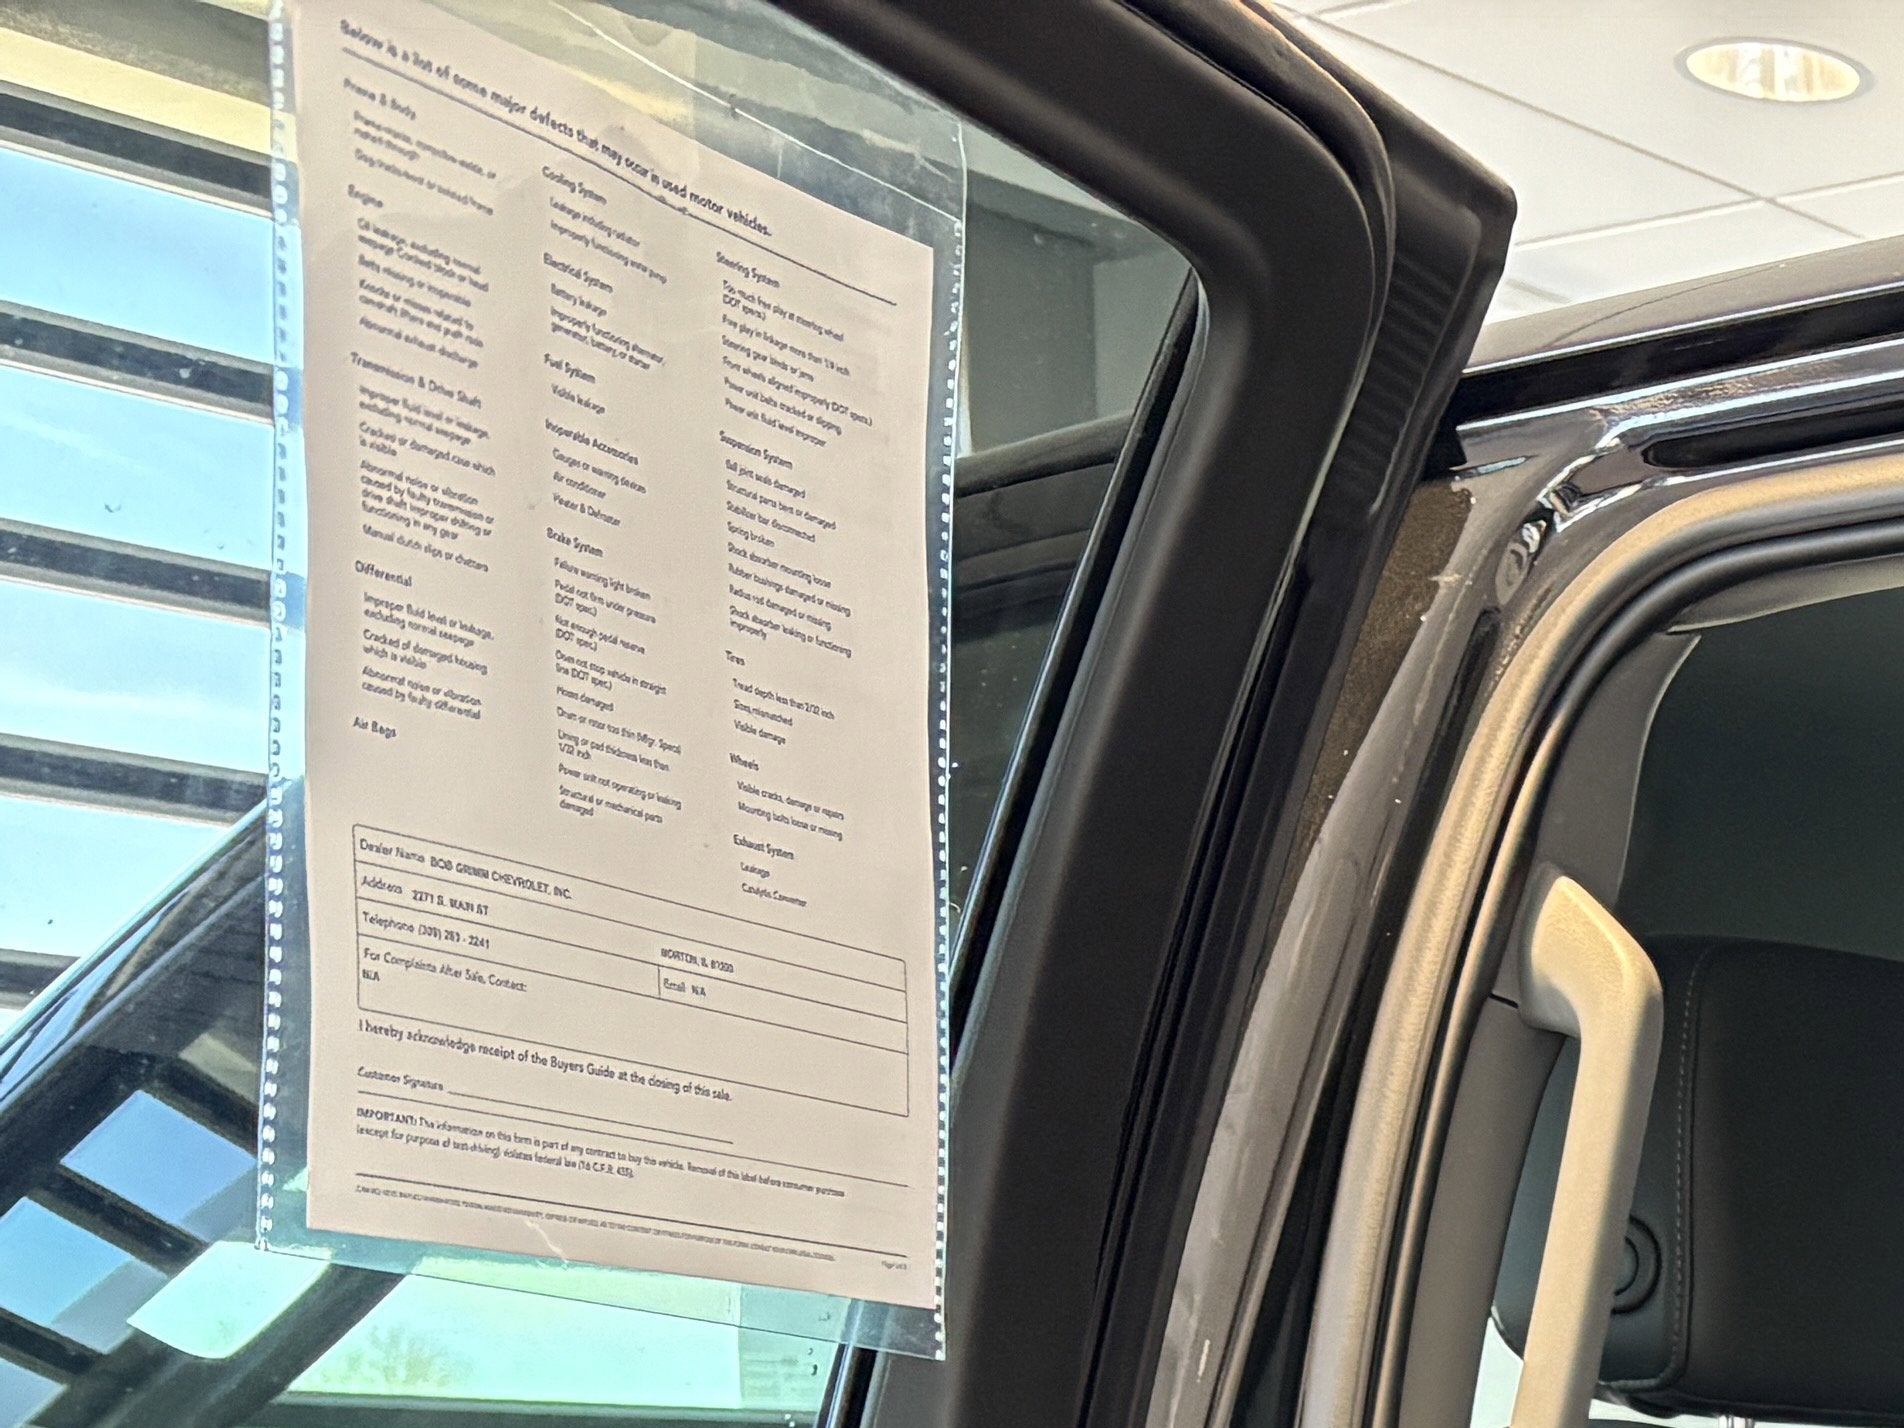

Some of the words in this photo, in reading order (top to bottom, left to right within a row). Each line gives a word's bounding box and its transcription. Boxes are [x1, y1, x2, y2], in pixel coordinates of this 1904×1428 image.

[477, 1044, 515, 1060] receipt
[530, 1051, 548, 1066] the
[549, 1055, 584, 1073] Buyers
[585, 1062, 615, 1079] Guide
[629, 1070, 645, 1085] the
[647, 1074, 680, 1095] closing
[693, 1083, 710, 1097] this
